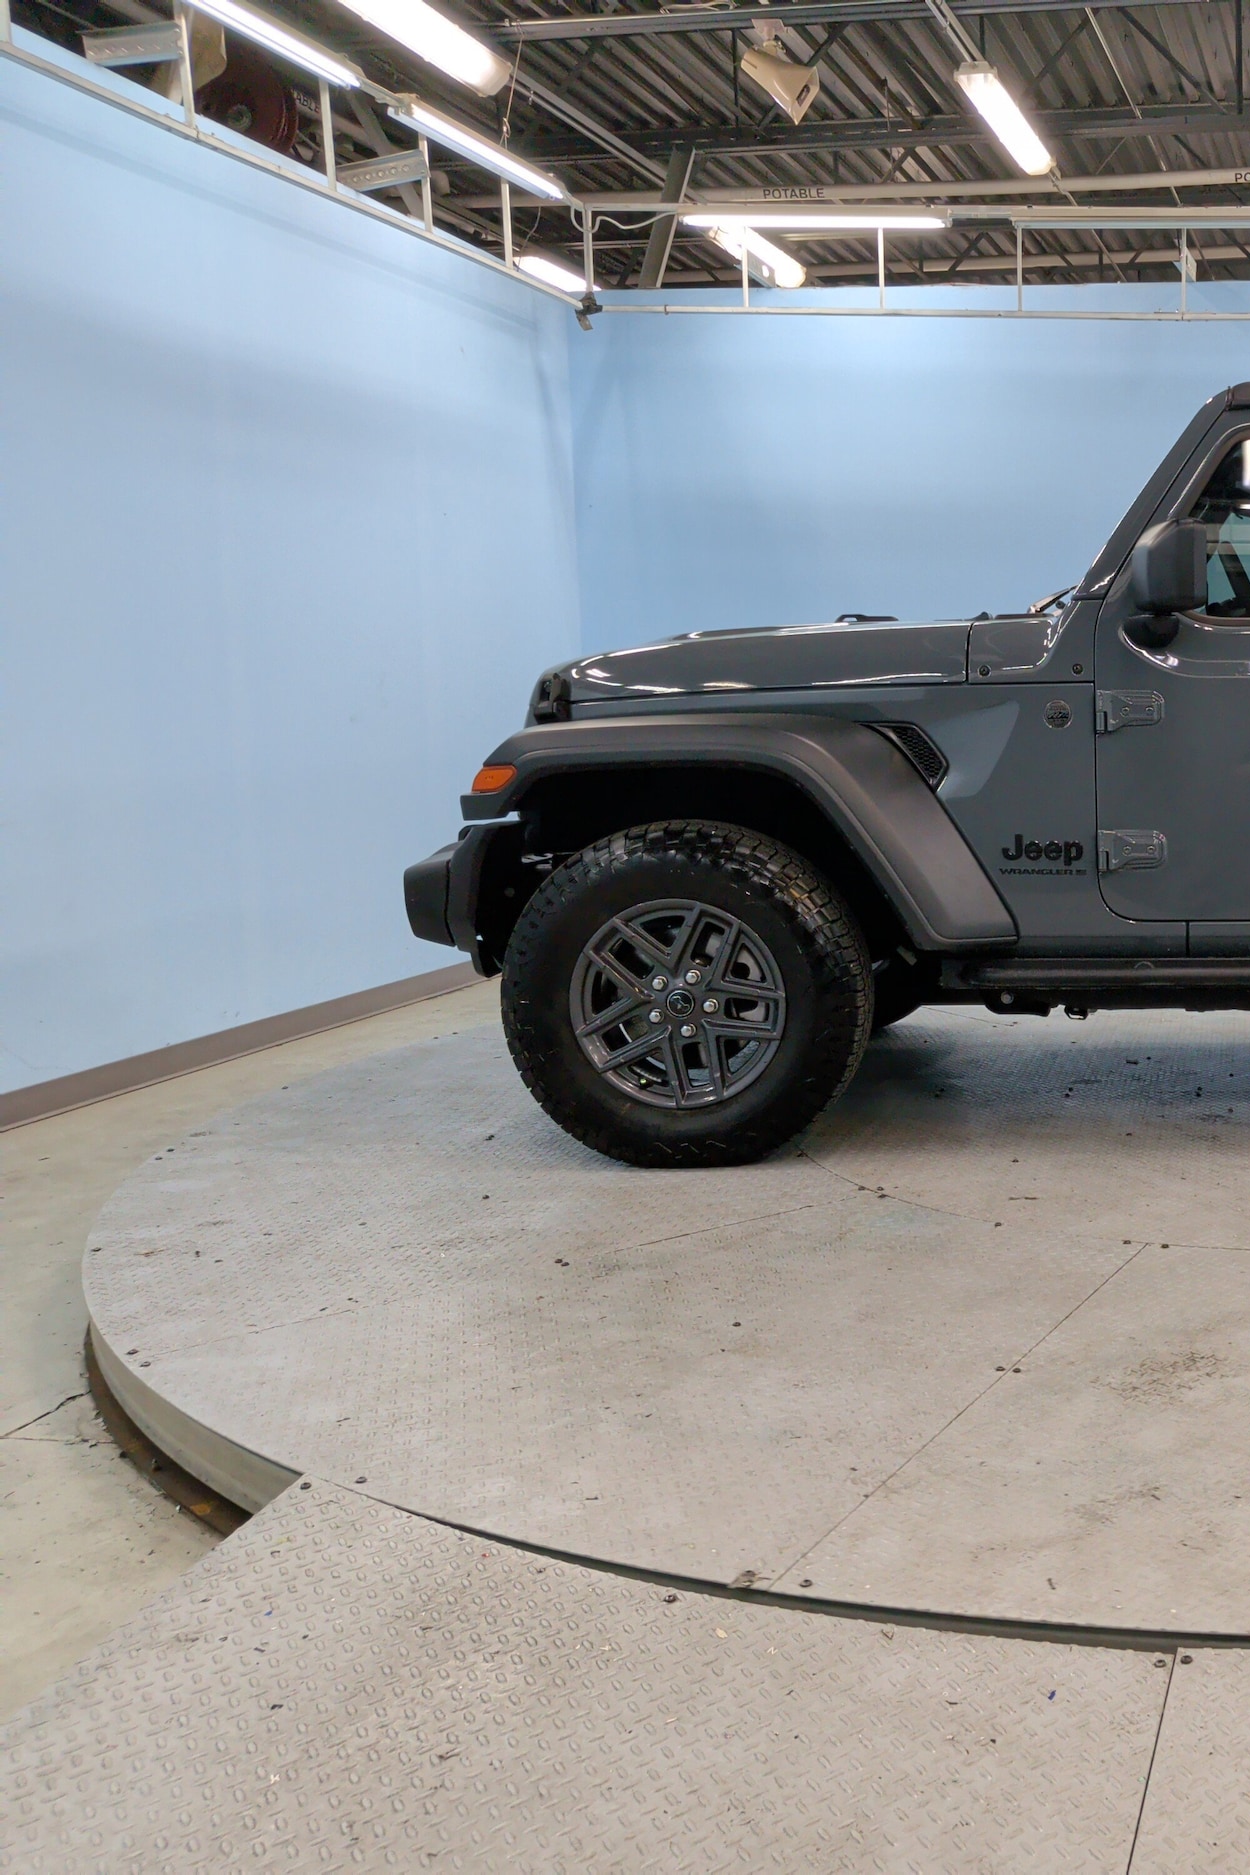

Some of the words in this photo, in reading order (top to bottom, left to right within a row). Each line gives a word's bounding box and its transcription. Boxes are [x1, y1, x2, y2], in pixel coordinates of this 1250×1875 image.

[762, 187, 825, 199] POTABLE
[1002, 833, 1083, 866] Jeep
[999, 867, 1074, 876] WRANGLER
